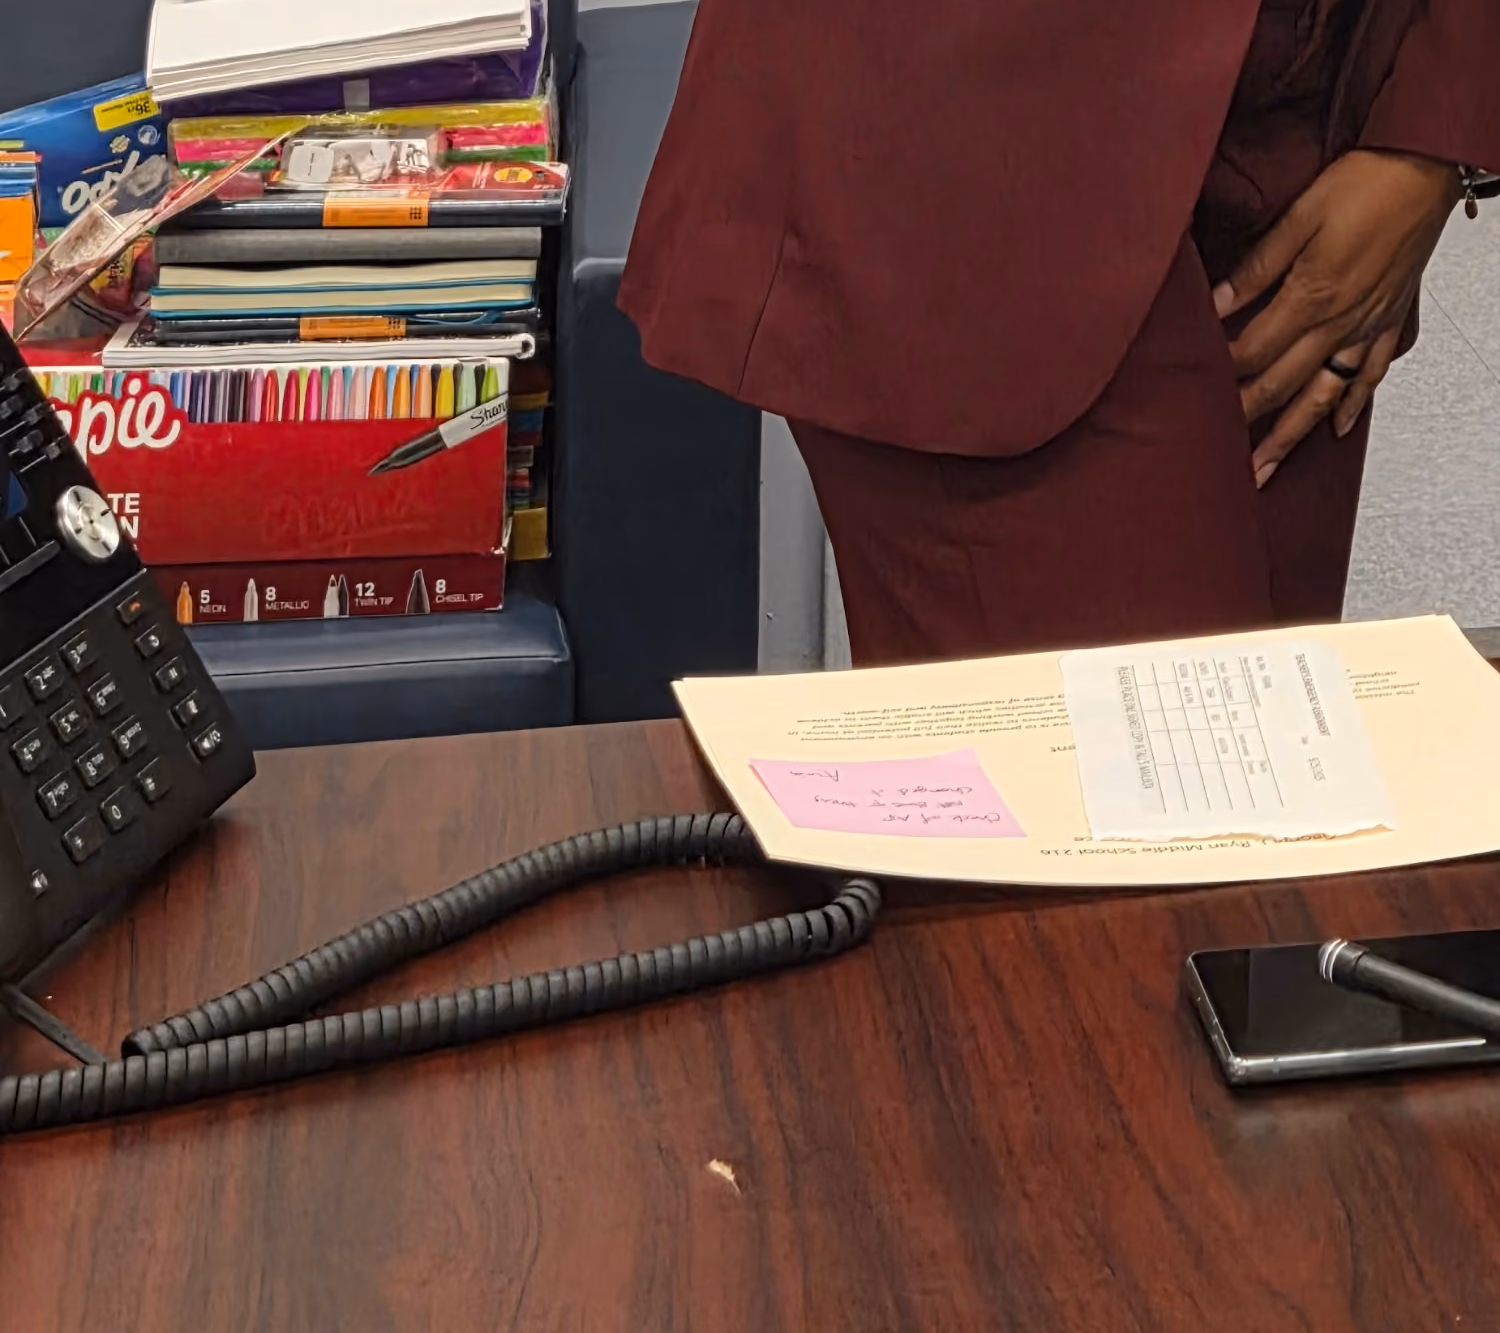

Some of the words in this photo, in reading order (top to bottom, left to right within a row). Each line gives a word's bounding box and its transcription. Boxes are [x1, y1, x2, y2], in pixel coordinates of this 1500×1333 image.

[355, 583, 375, 597] 12
[435, 579, 446, 593] 8
[200, 590, 210, 603] 5
[265, 587, 276, 601] 8
[1079, 846, 1137, 855] School
[1142, 844, 1203, 853] Middle
[1209, 840, 1251, 849] Ryan
